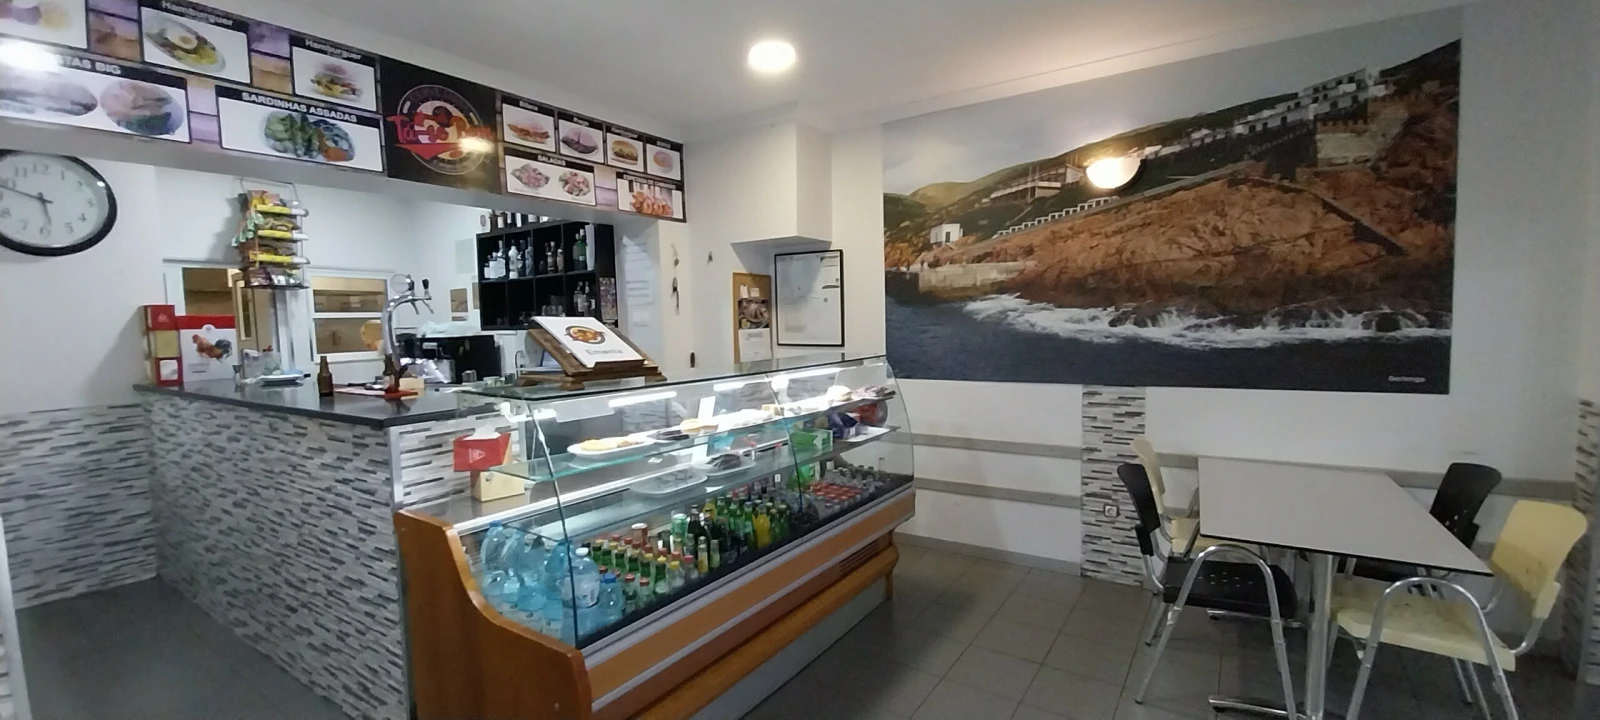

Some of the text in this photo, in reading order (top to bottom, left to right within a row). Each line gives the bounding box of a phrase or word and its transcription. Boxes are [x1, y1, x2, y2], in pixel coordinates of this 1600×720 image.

[161, 1, 234, 26] Hamburguer
[305, 38, 362, 60] Hamburguer
[94, 61, 121, 75] BIG
[241, 92, 358, 123] SARDINHAS ASSADAS
[14, 166, 27, 178] 11
[33, 163, 50, 176] 12
[77, 212, 87, 222] 4
[40, 225, 51, 237] 6
[64, 222, 74, 234] 5
